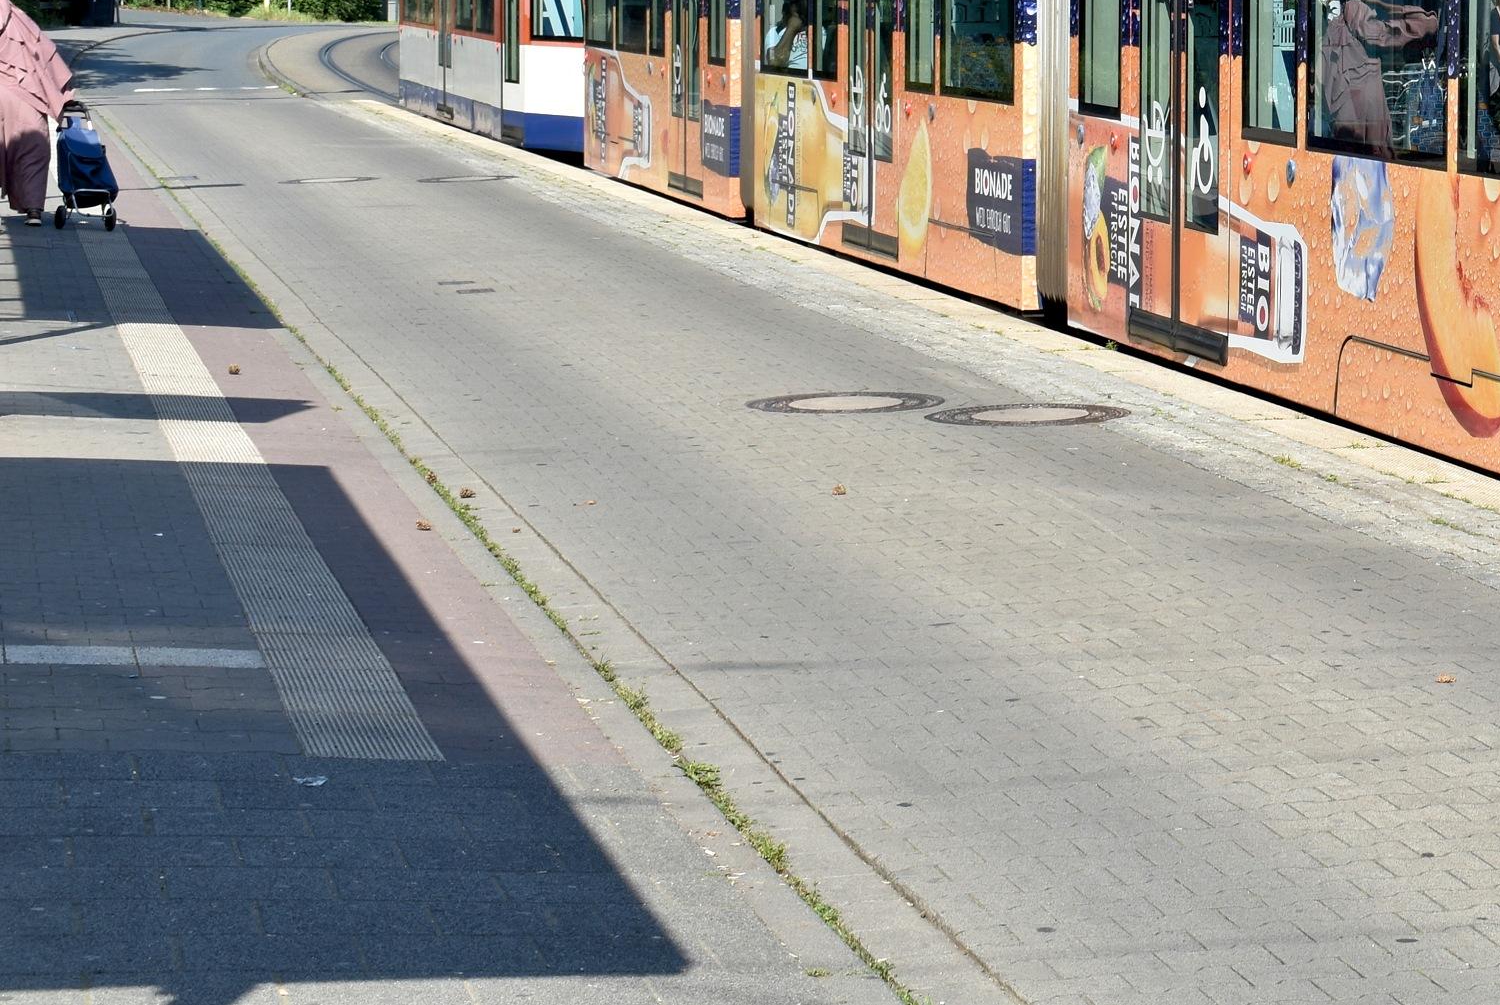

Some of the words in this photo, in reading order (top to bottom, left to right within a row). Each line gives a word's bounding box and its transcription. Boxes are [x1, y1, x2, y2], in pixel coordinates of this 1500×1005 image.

[974, 167, 1013, 201] BIONADE
[1117, 188, 1128, 283] EISTEE
[1247, 246, 1257, 317] EISTEE
[1256, 242, 1271, 332] BIO
